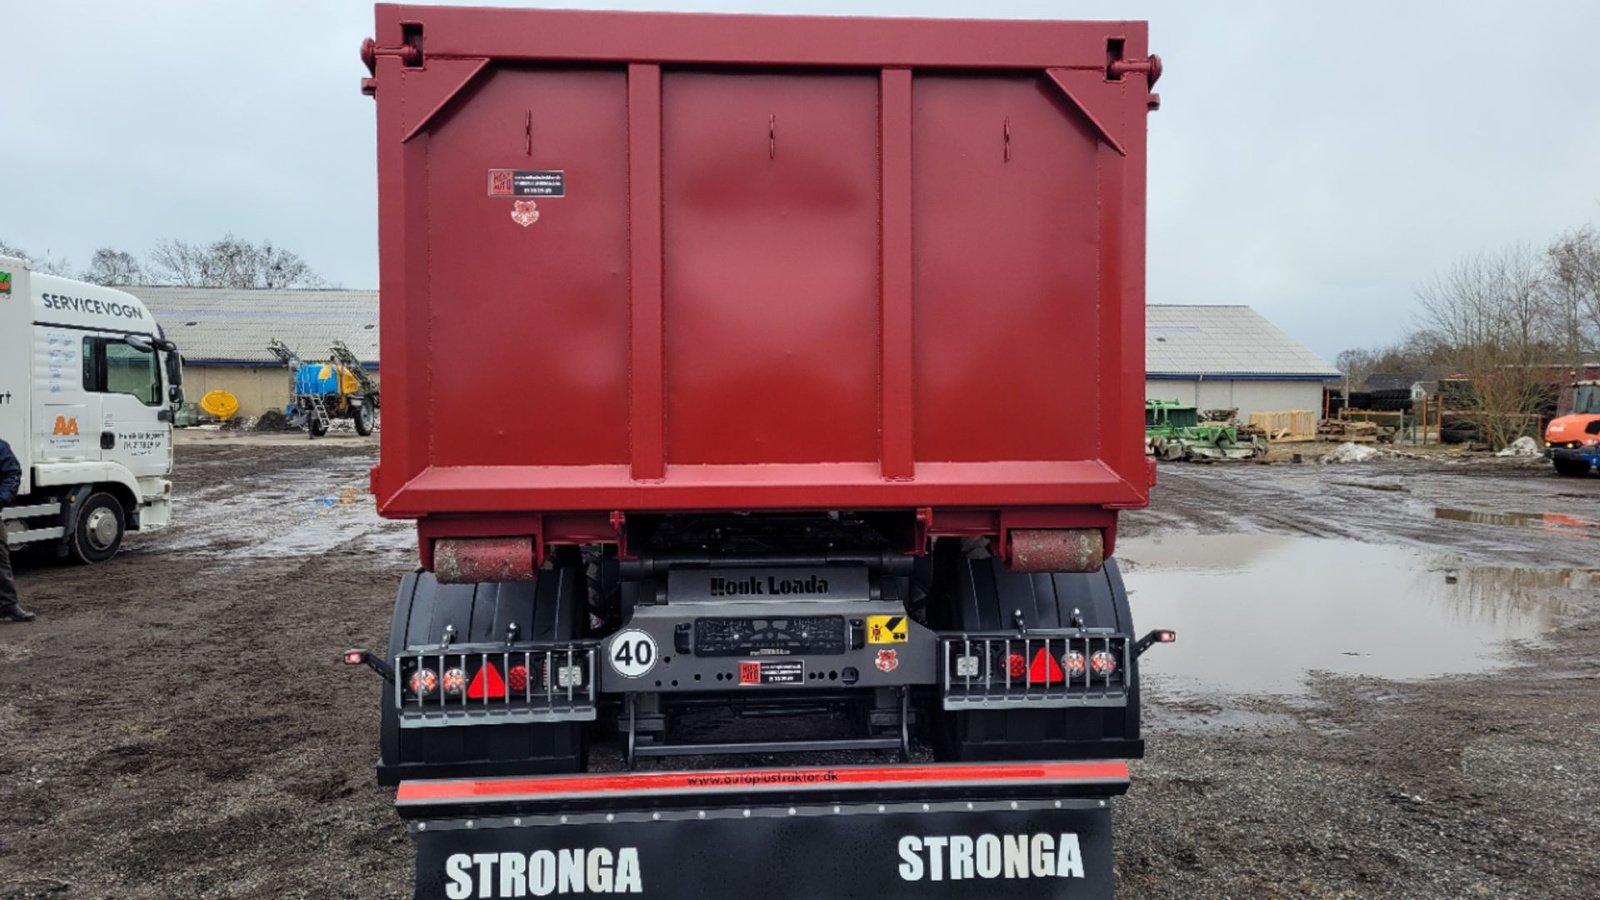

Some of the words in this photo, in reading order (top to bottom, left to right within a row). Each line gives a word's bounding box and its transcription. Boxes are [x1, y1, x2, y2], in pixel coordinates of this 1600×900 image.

[42, 293, 143, 319] SERVICEVOGN
[711, 576, 763, 596] Hook
[768, 575, 828, 595] Loada
[614, 640, 652, 666] 40
[688, 770, 838, 786] www.autoplustraktor.dk
[898, 833, 1085, 881] STRONGA
[445, 847, 643, 900] STRONGA
